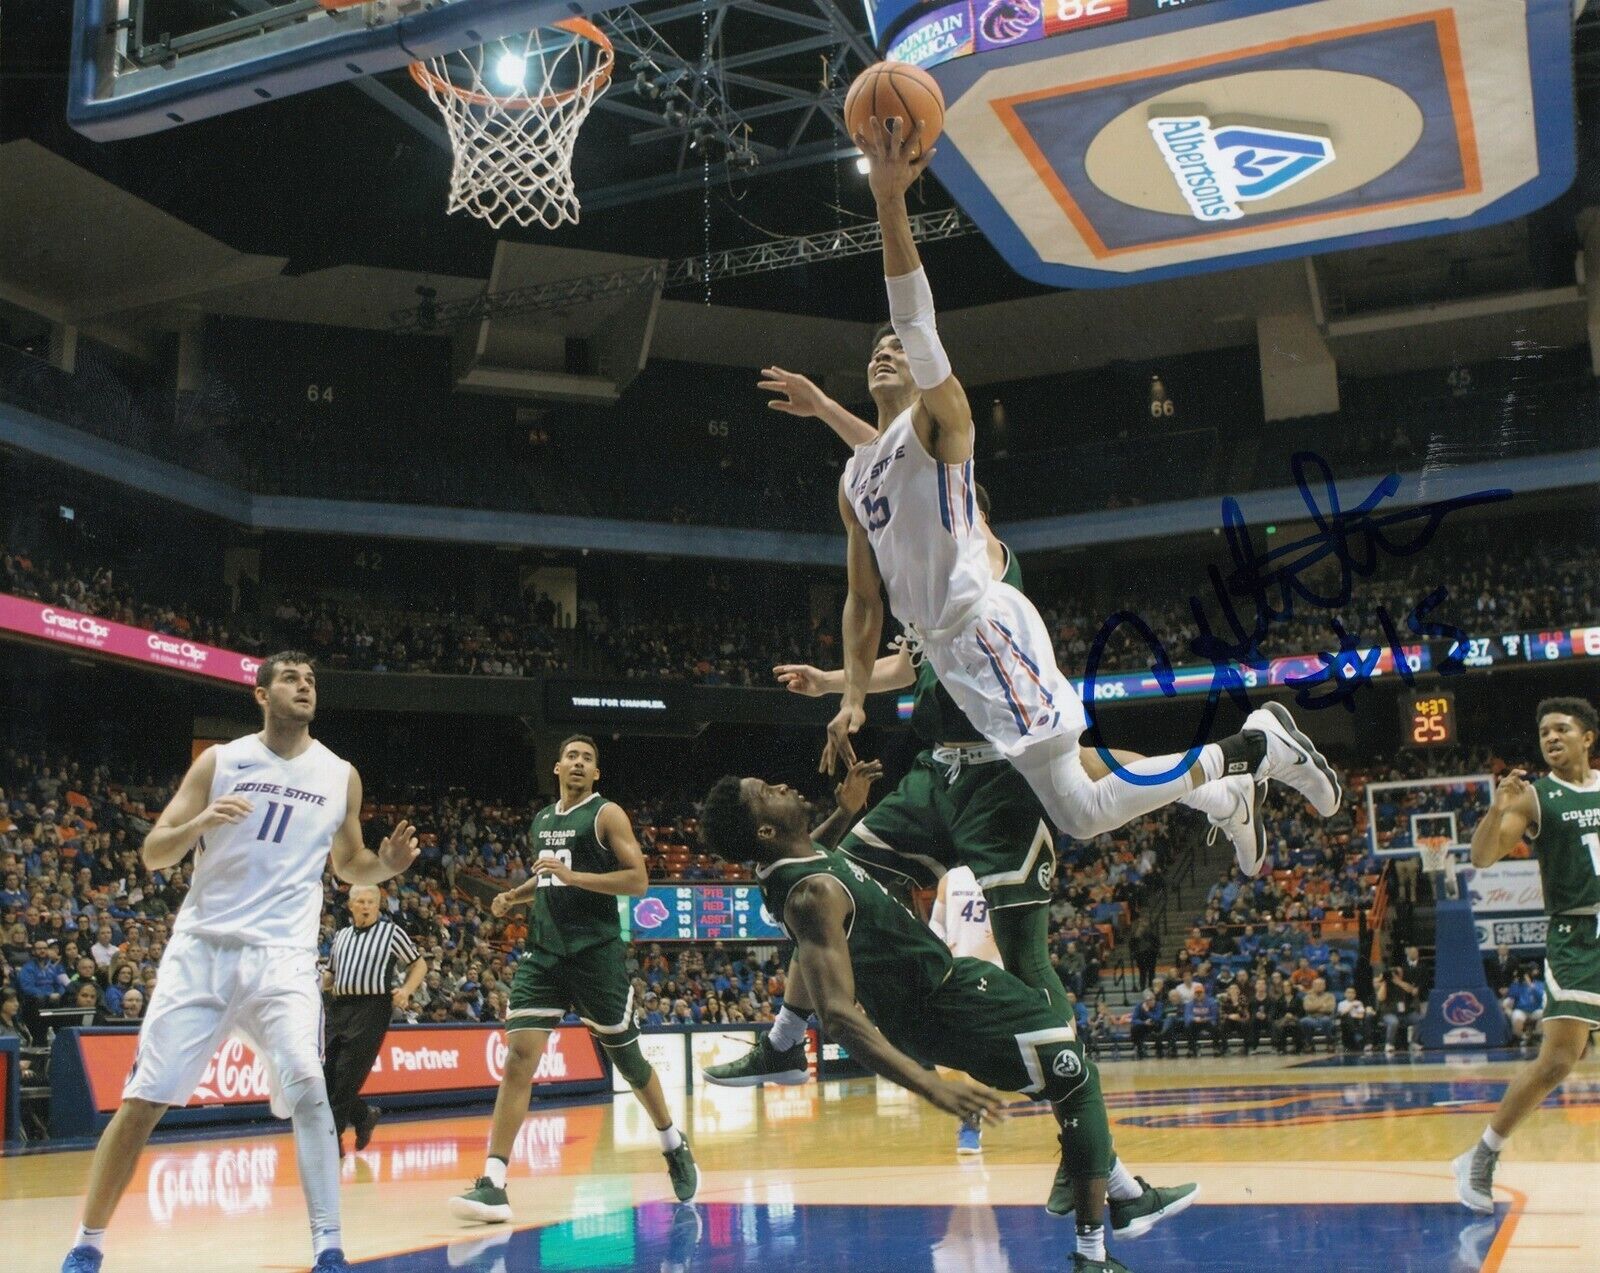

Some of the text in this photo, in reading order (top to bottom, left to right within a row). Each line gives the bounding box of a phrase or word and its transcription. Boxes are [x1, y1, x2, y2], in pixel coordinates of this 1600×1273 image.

[1157, 119, 1231, 217] Albertsons
[307, 384, 333, 402] 64
[1151, 400, 1174, 417] 66
[708, 420, 729, 437] 65
[41, 608, 78, 631] Great
[79, 616, 110, 638] Clips
[147, 635, 180, 653] Great
[181, 643, 208, 661] Clips
[1416, 699, 1447, 715] 4:37
[1414, 716, 1446, 742] 25
[233, 783, 327, 807] BOISE STATE
[257, 801, 294, 843] 11
[960, 900, 988, 923] 43
[390, 1046, 459, 1072] Partner
